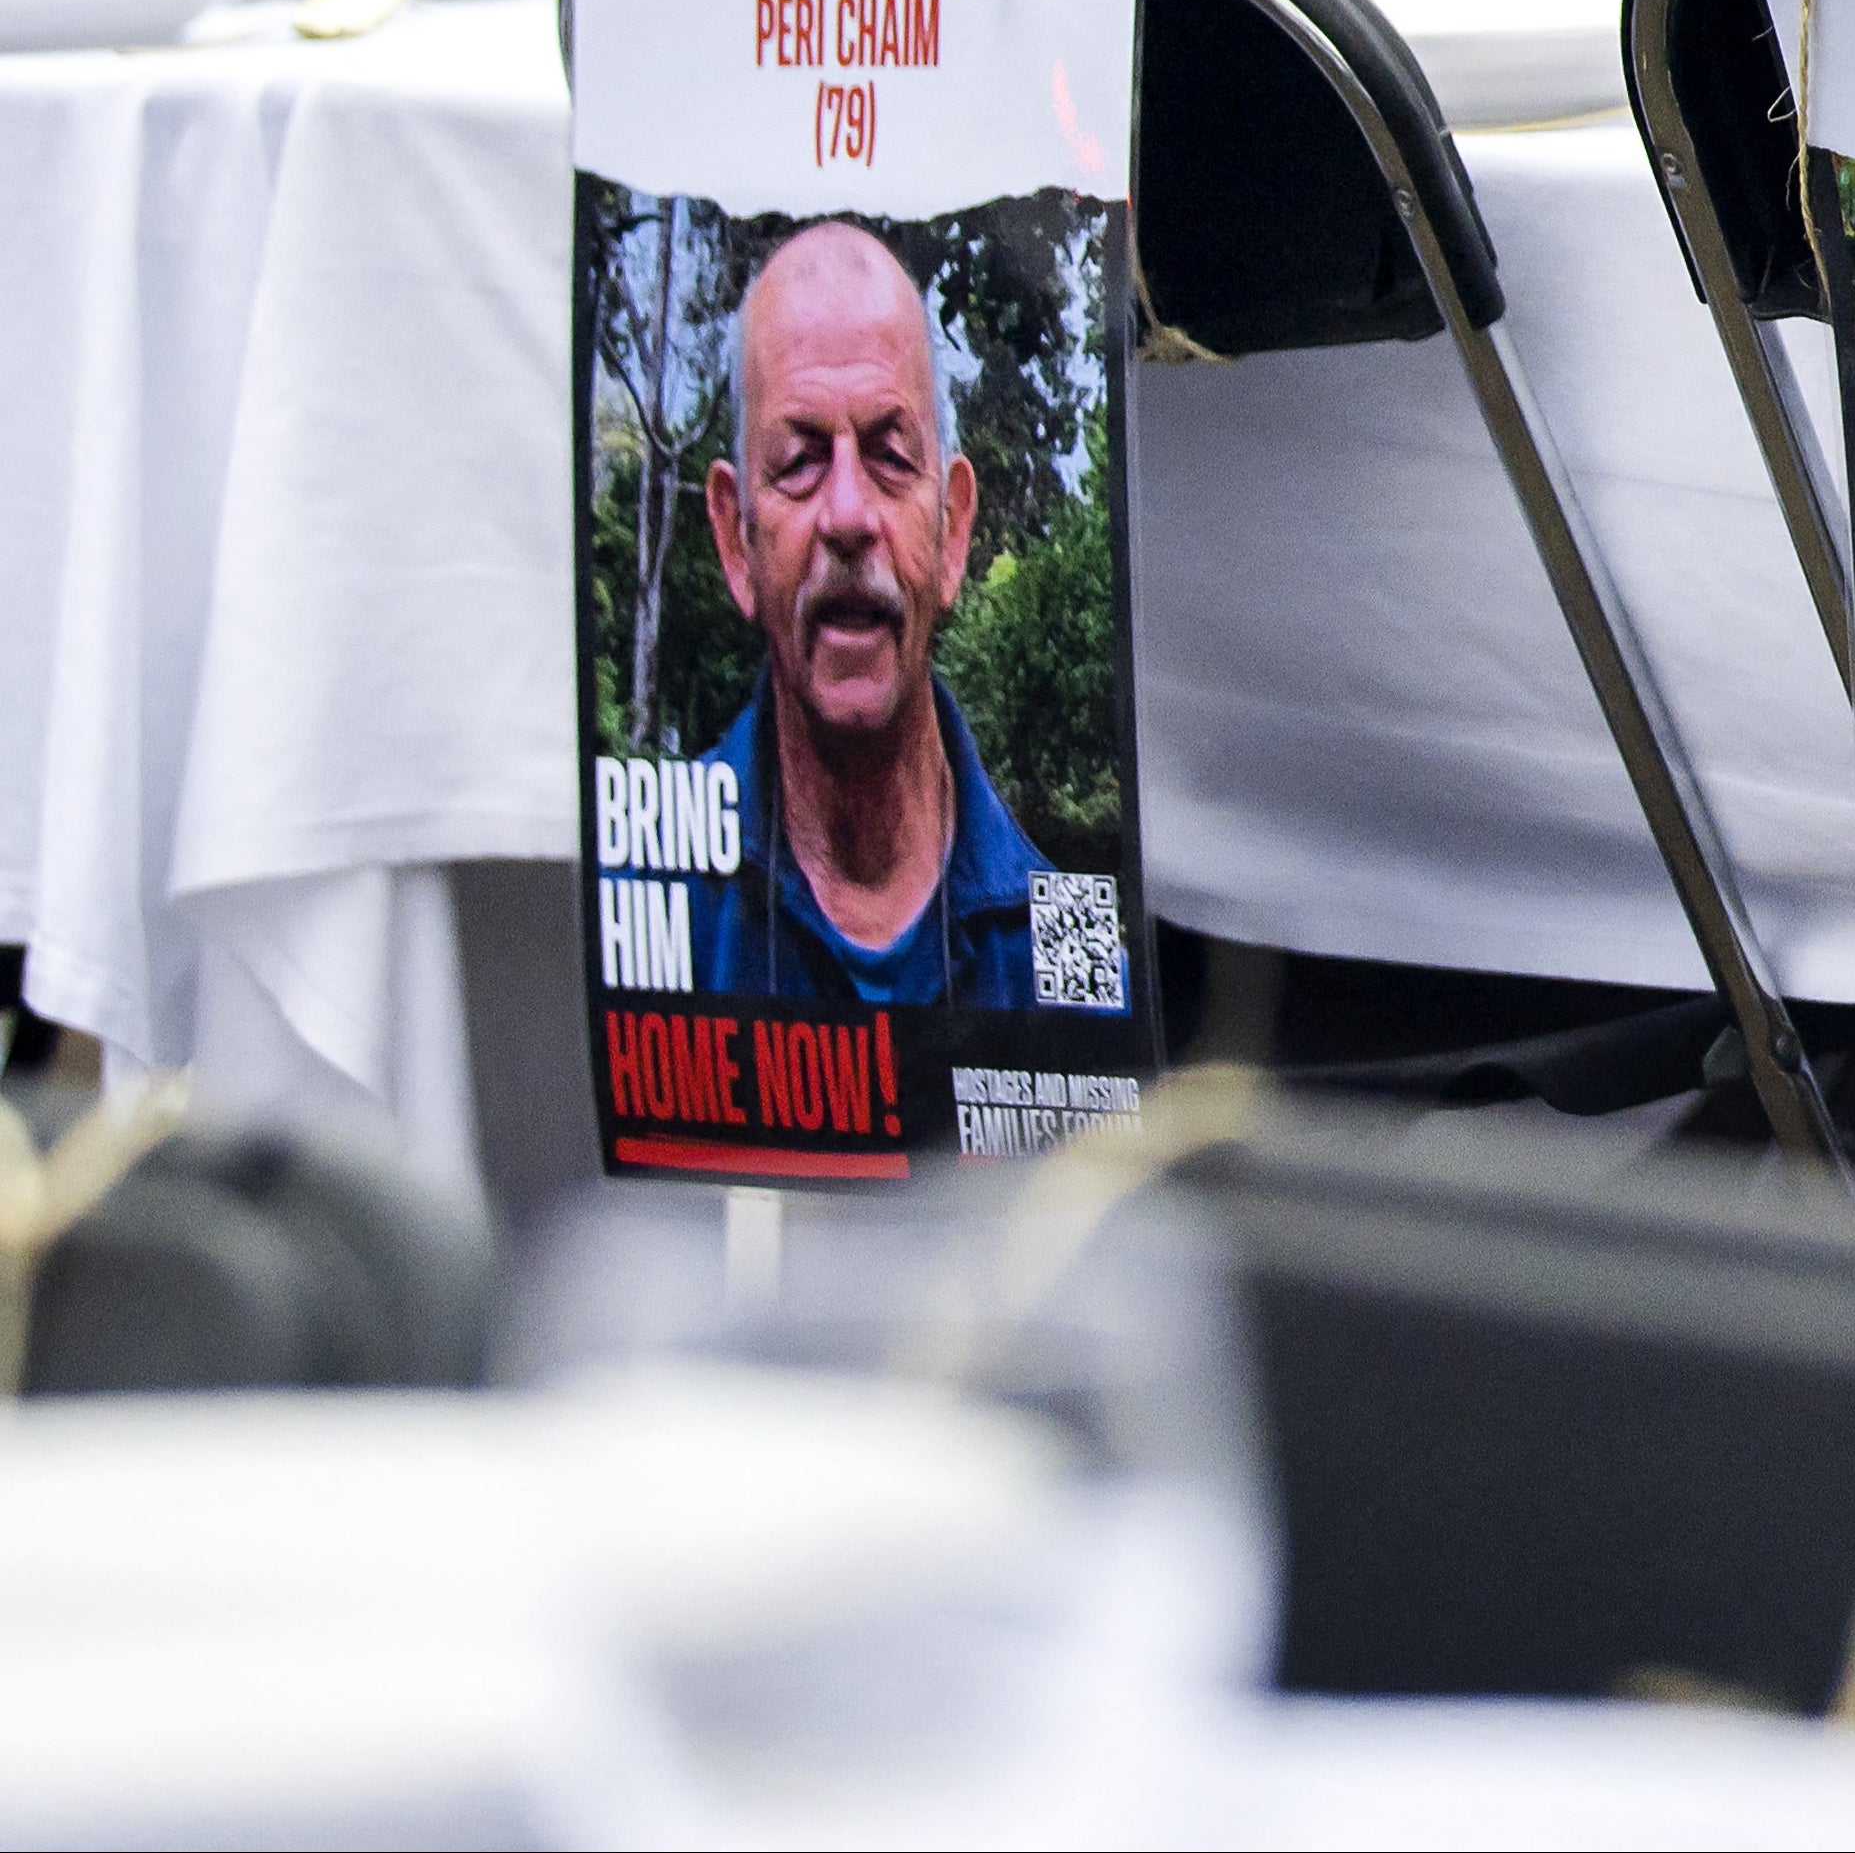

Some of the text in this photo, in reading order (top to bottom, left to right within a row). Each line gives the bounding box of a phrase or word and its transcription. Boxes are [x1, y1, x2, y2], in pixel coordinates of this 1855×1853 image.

[815, 80, 876, 167] (79)
[596, 756, 741, 875] BRING
[599, 877, 694, 993] HIM
[605, 1010, 902, 1137] HOME NOW!
[952, 1066, 1140, 1112] HOSTAGES AND MISSING
[957, 1104, 1057, 1157] FAMILIES
